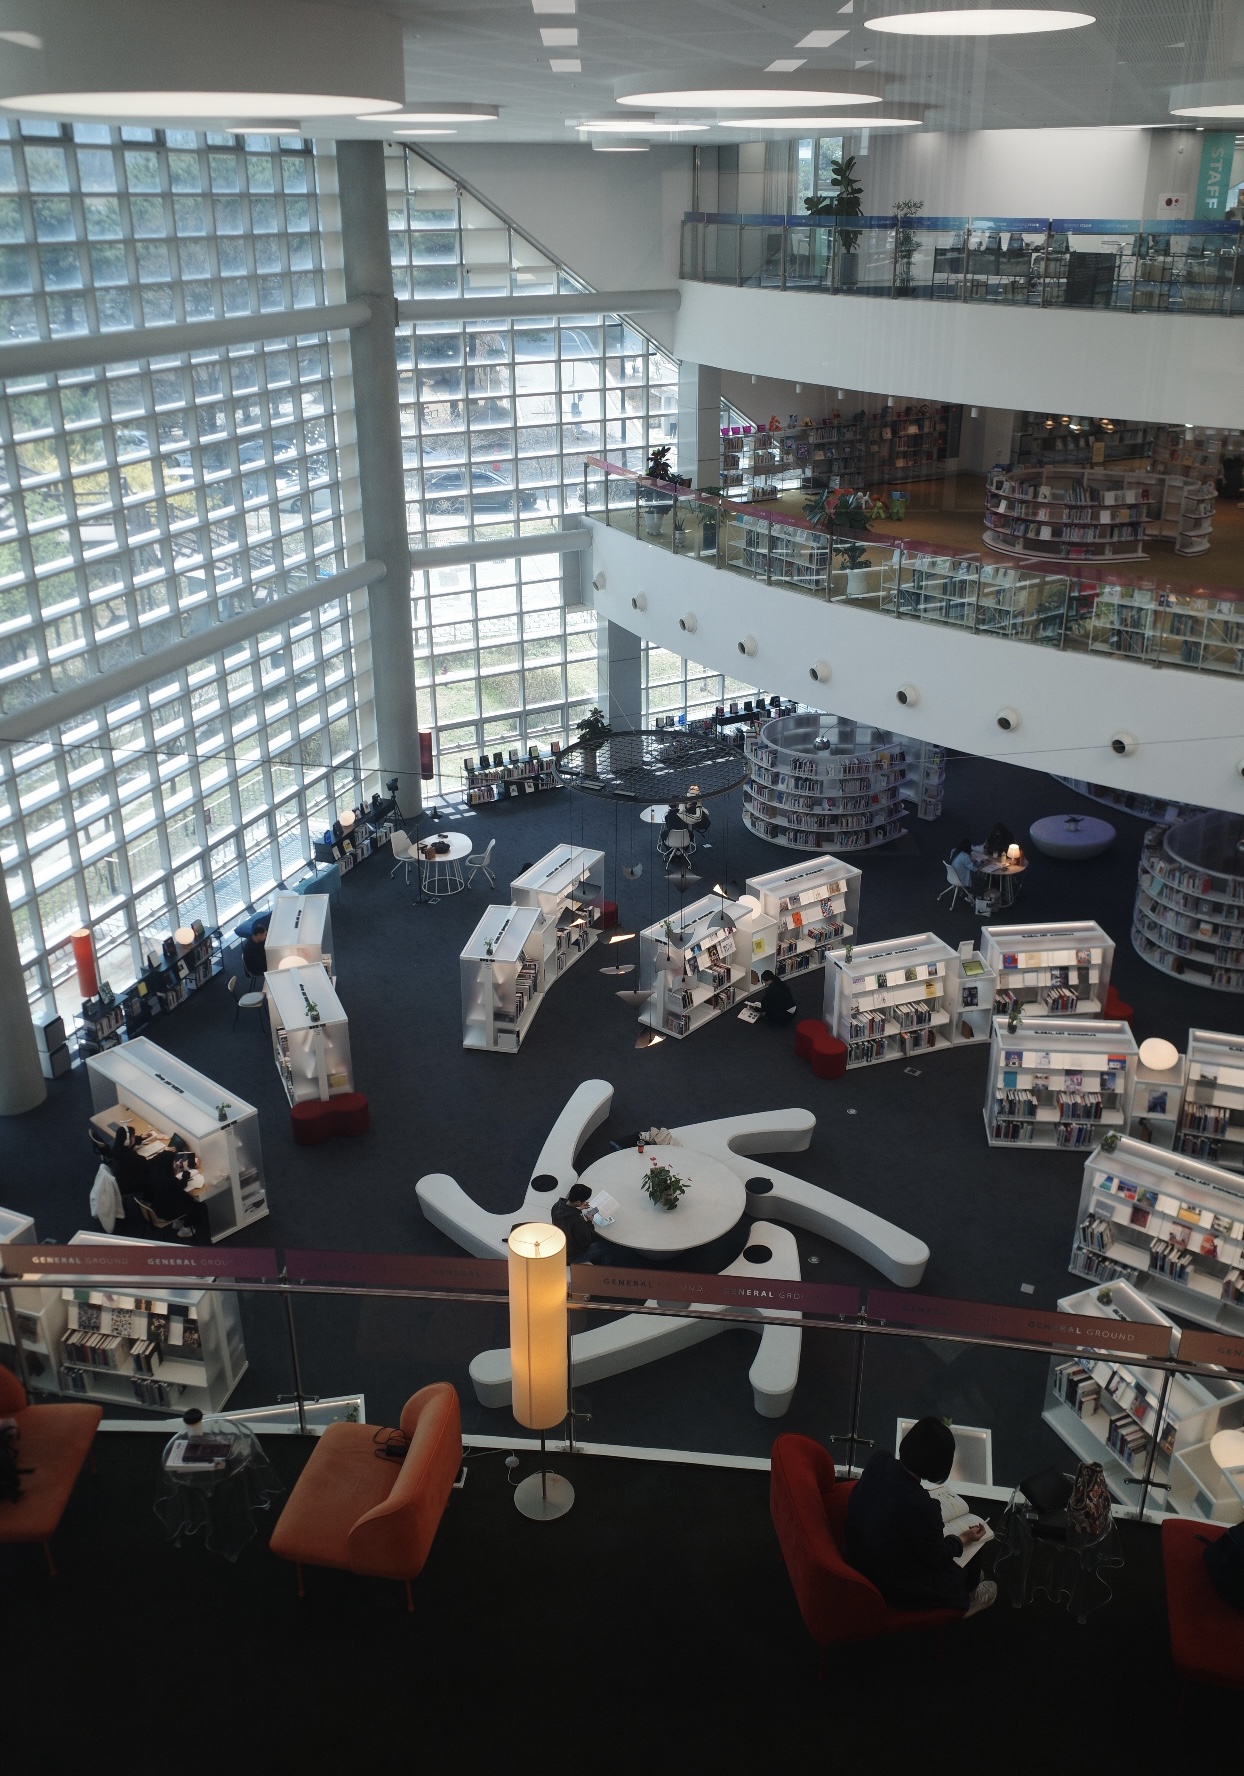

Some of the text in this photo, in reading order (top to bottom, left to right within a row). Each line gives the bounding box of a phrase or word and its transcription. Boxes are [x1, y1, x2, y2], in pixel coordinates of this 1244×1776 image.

[1205, 146, 1225, 209] STAFF
[31, 1256, 129, 1265] GENERAL GROUND
[147, 1258, 197, 1266] GENERAL
[603, 1278, 654, 1288] GENERAL
[723, 1287, 774, 1298] GENERAL
[1027, 1321, 1136, 1342] GENERAL GROUND
